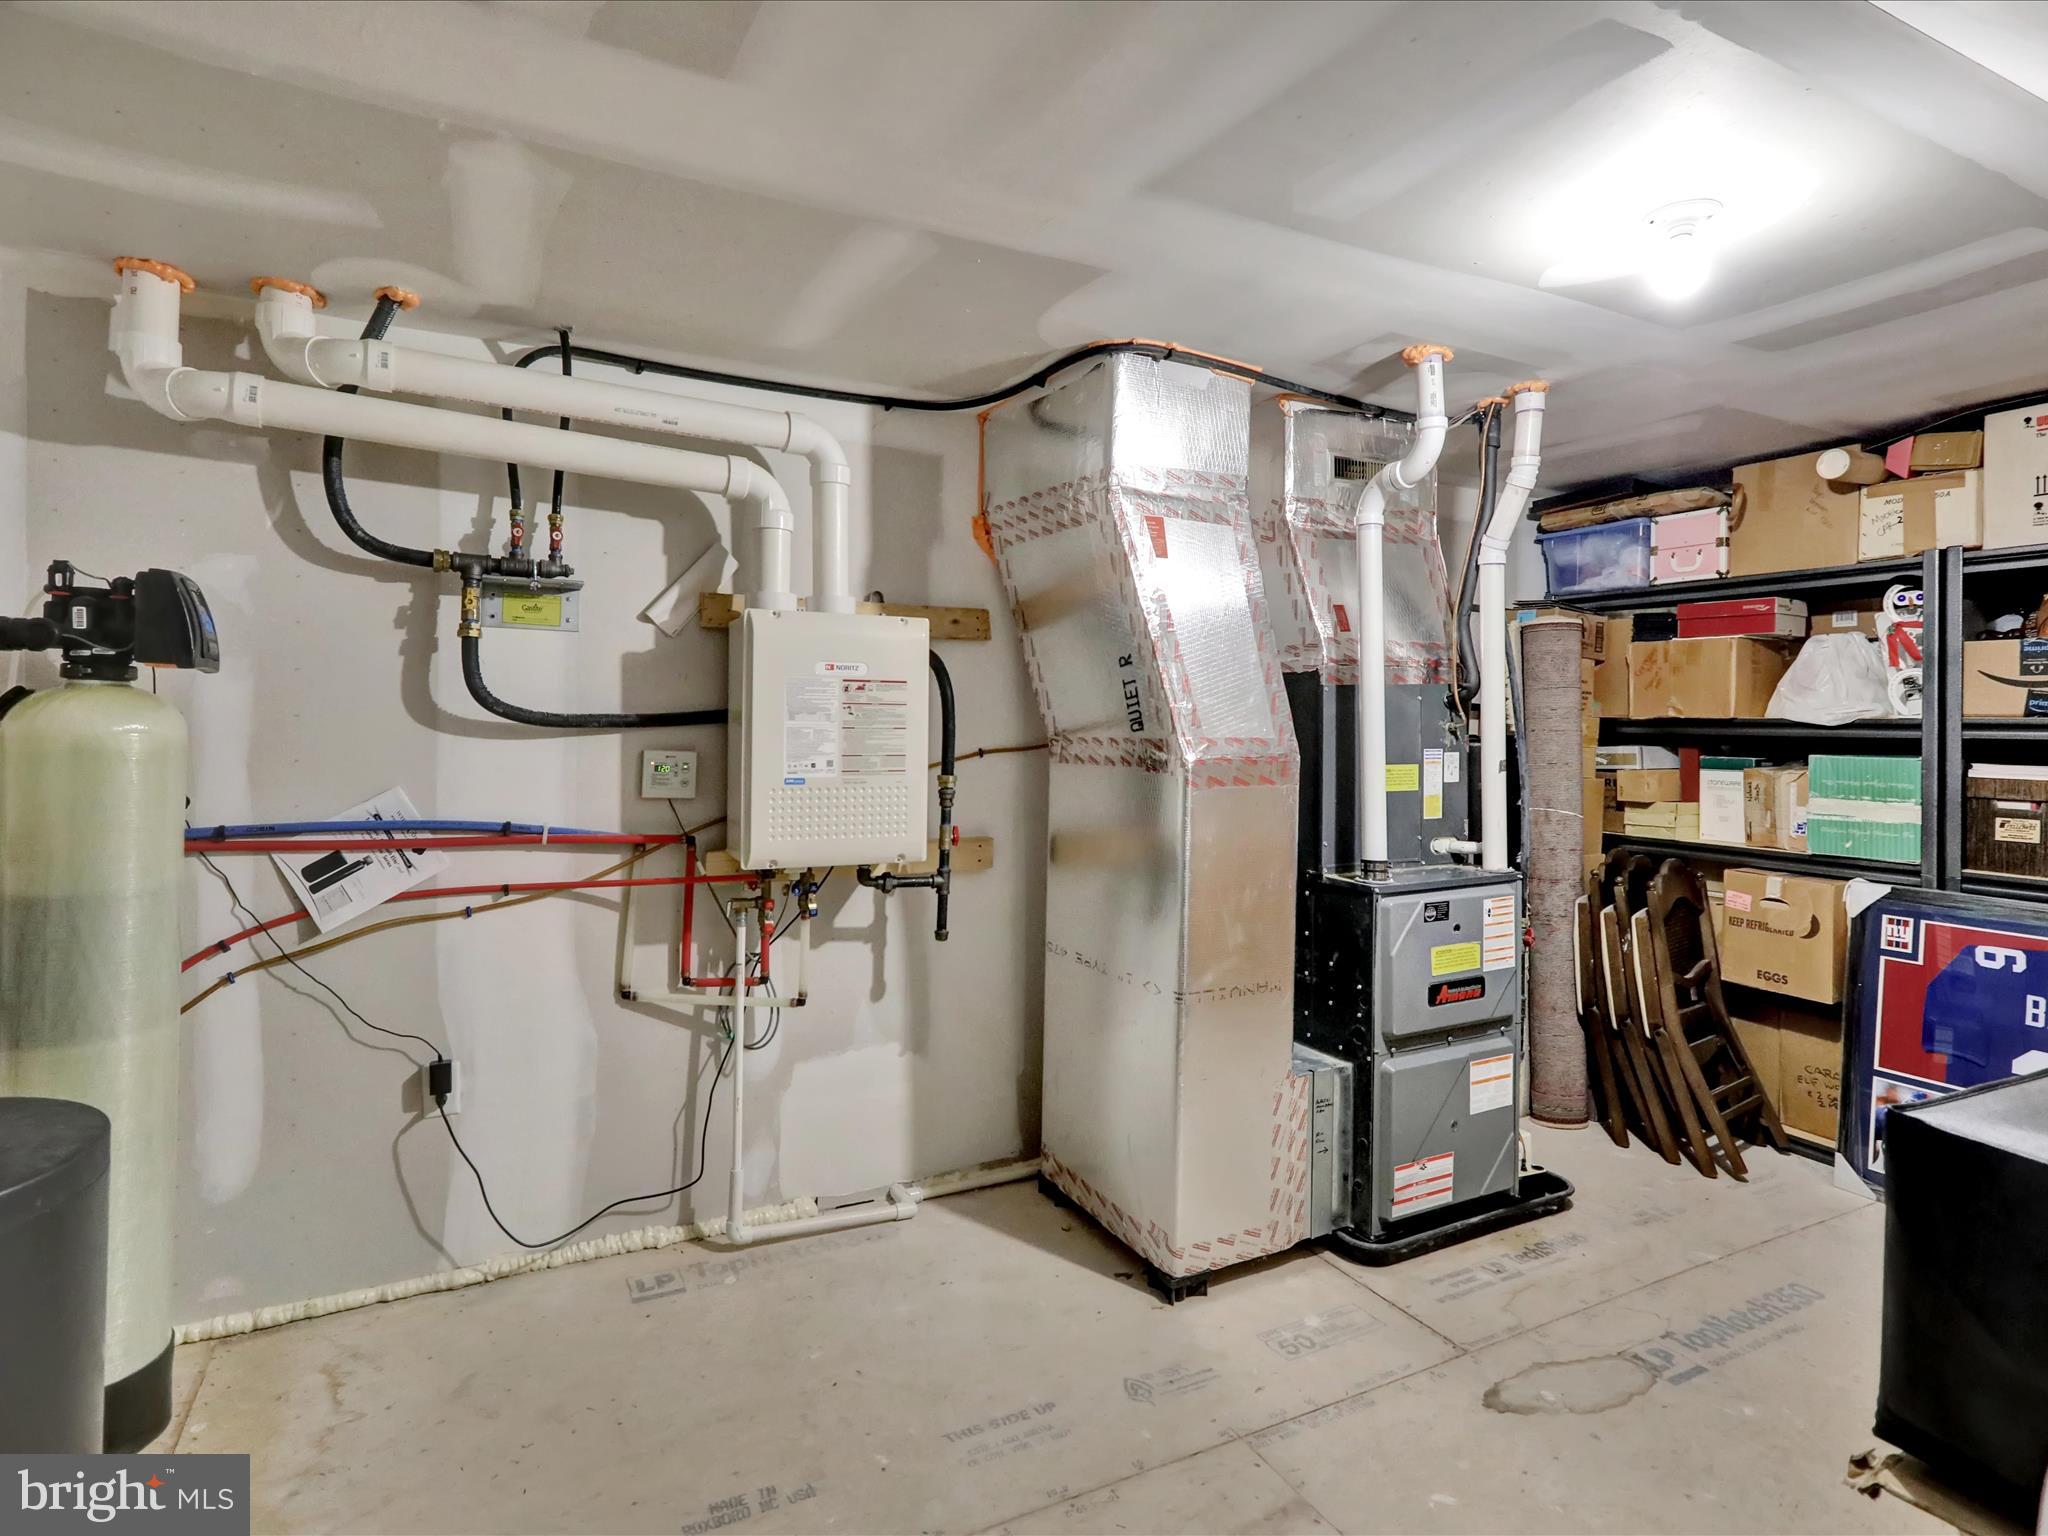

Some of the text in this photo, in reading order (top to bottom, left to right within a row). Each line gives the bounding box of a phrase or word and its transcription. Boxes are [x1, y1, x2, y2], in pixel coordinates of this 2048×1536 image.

[836, 664, 859, 672] NORITZ
[1118, 653, 1144, 732] QUIET R
[657, 765, 670, 773] 120
[1728, 916, 1744, 928] KEEP
[1756, 969, 1788, 985] EGGS
[1435, 984, 1482, 1005] Amana
[634, 1273, 676, 1294] LP
[941, 1401, 1056, 1443] THIS SIDE UP
[681, 1505, 751, 1536] ROXBORO
[786, 1482, 817, 1505] USA
[708, 1485, 777, 1514] MADE IN
